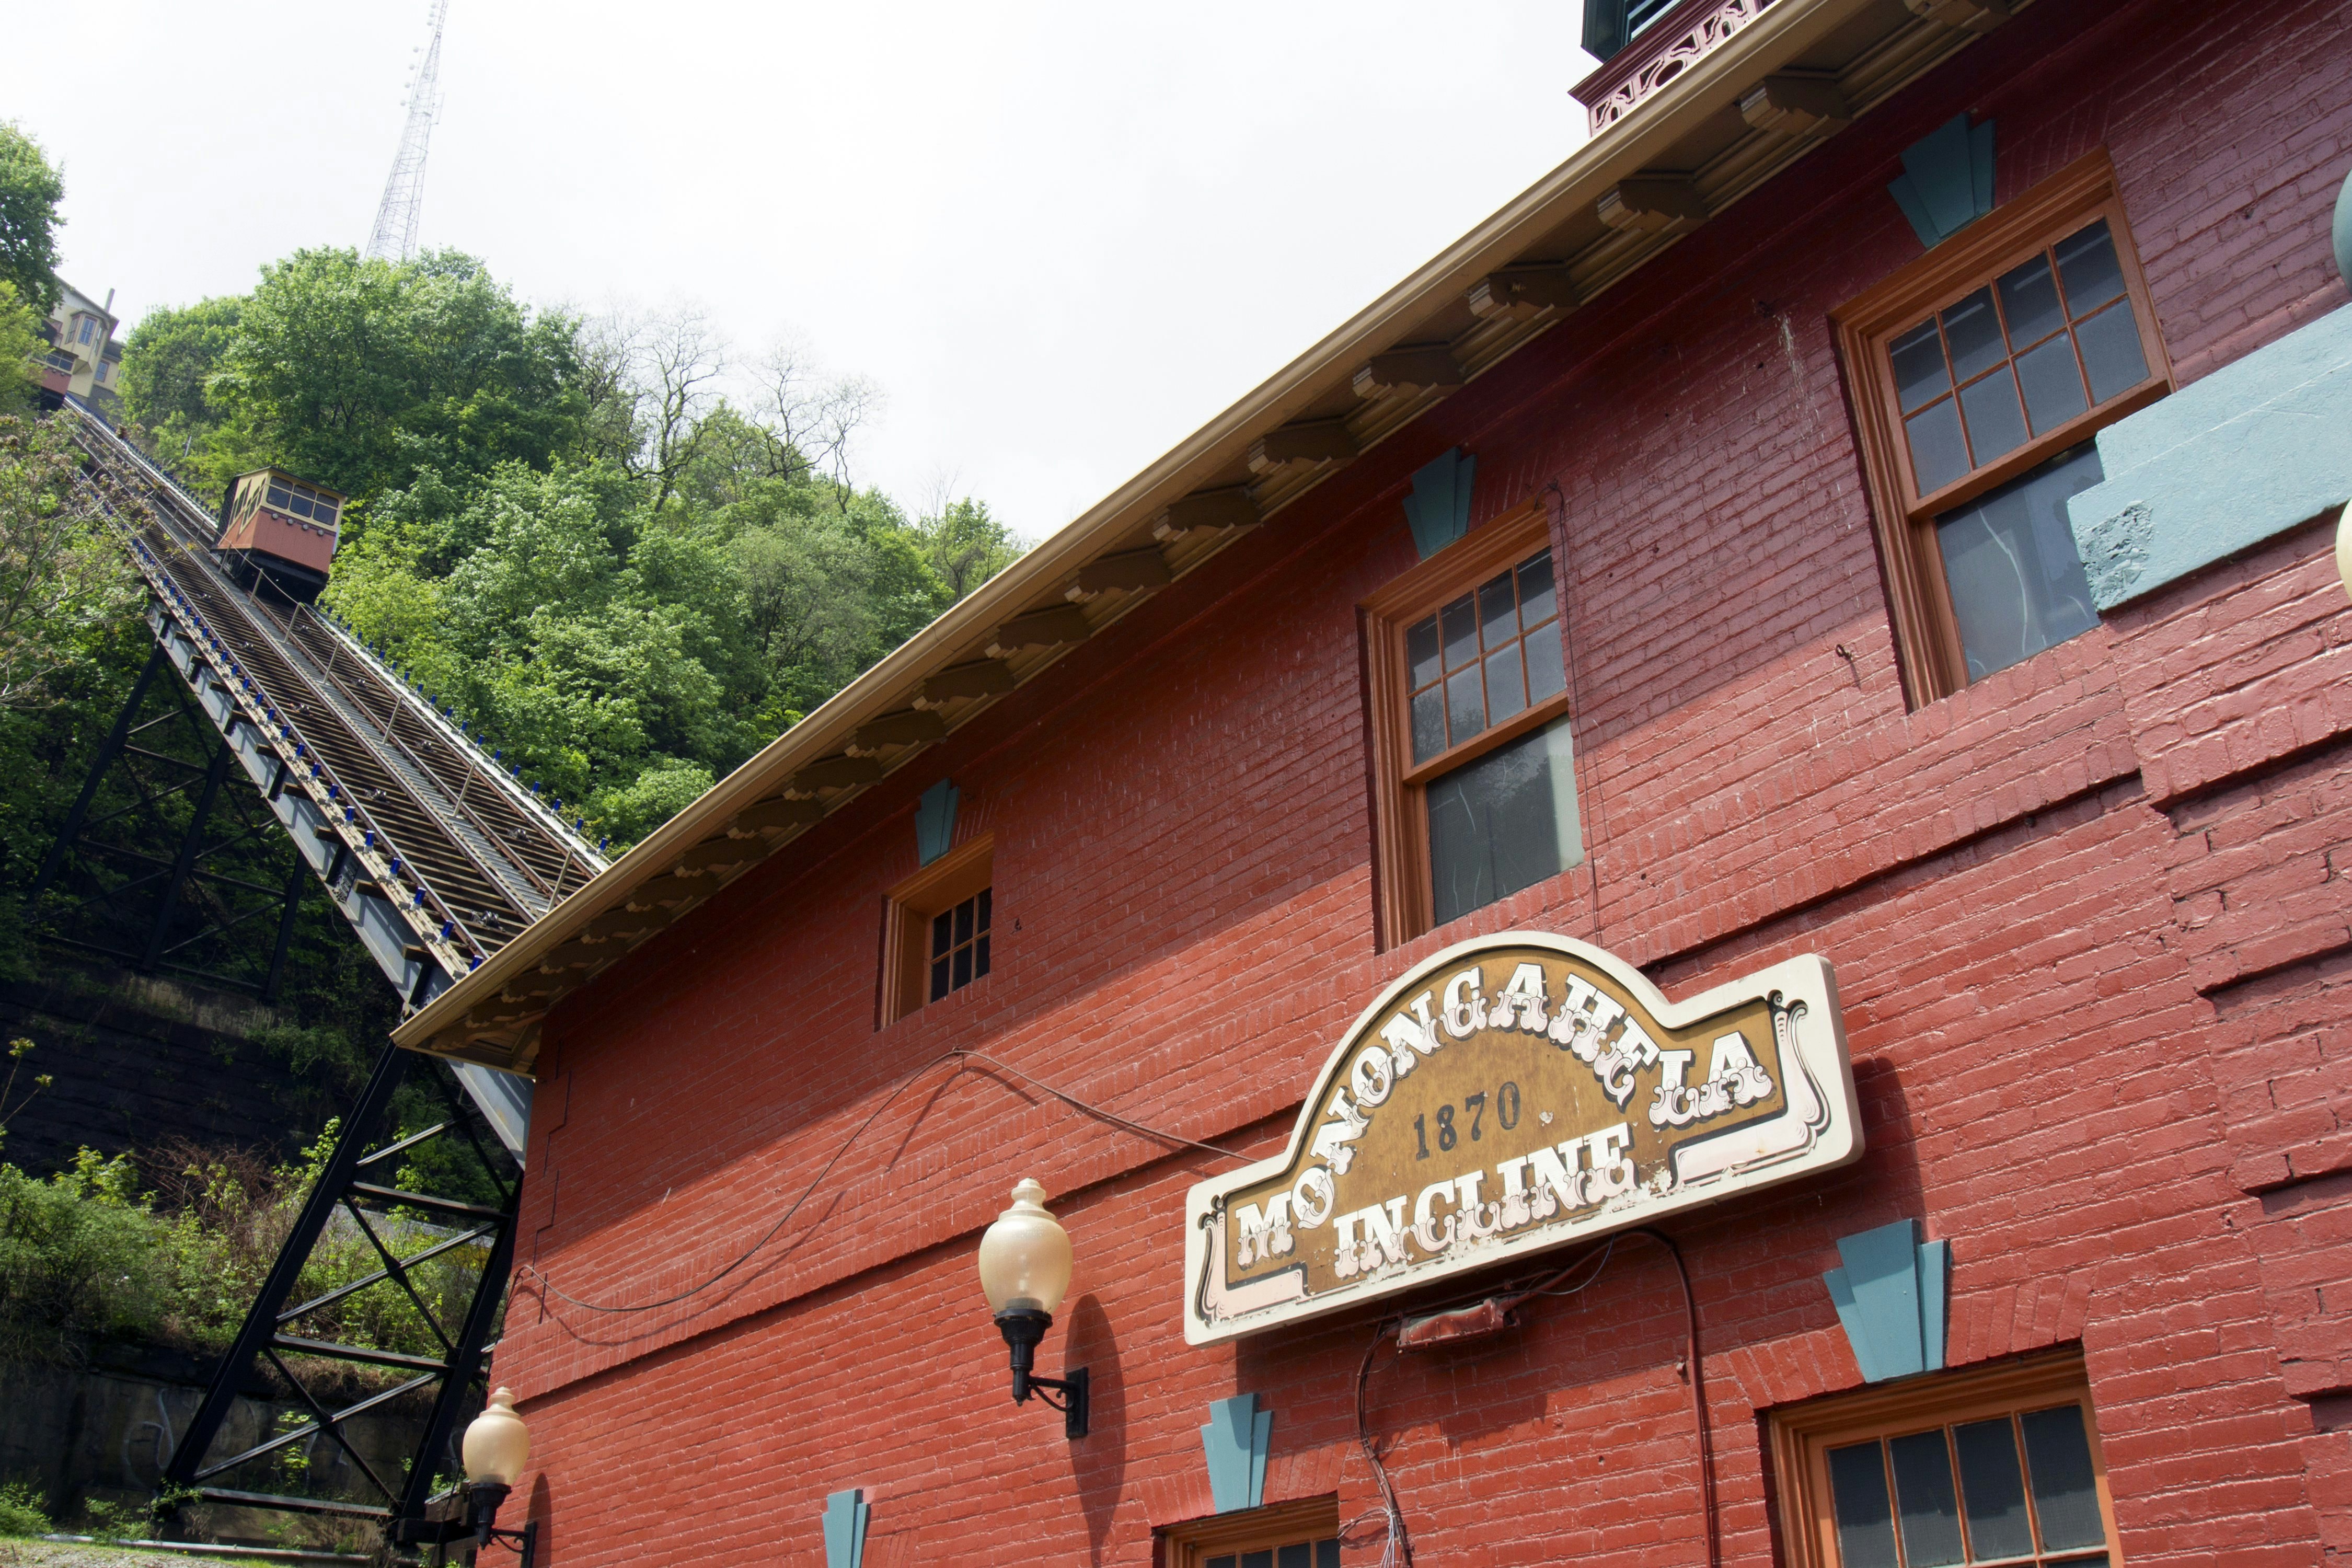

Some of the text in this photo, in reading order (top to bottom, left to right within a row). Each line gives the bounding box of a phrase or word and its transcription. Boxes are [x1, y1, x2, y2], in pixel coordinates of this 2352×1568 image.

[1235, 963, 1774, 1269] MONONGAHELA
[1414, 1081, 1520, 1161] 1870
[1333, 1122, 1640, 1279] INCLINE
